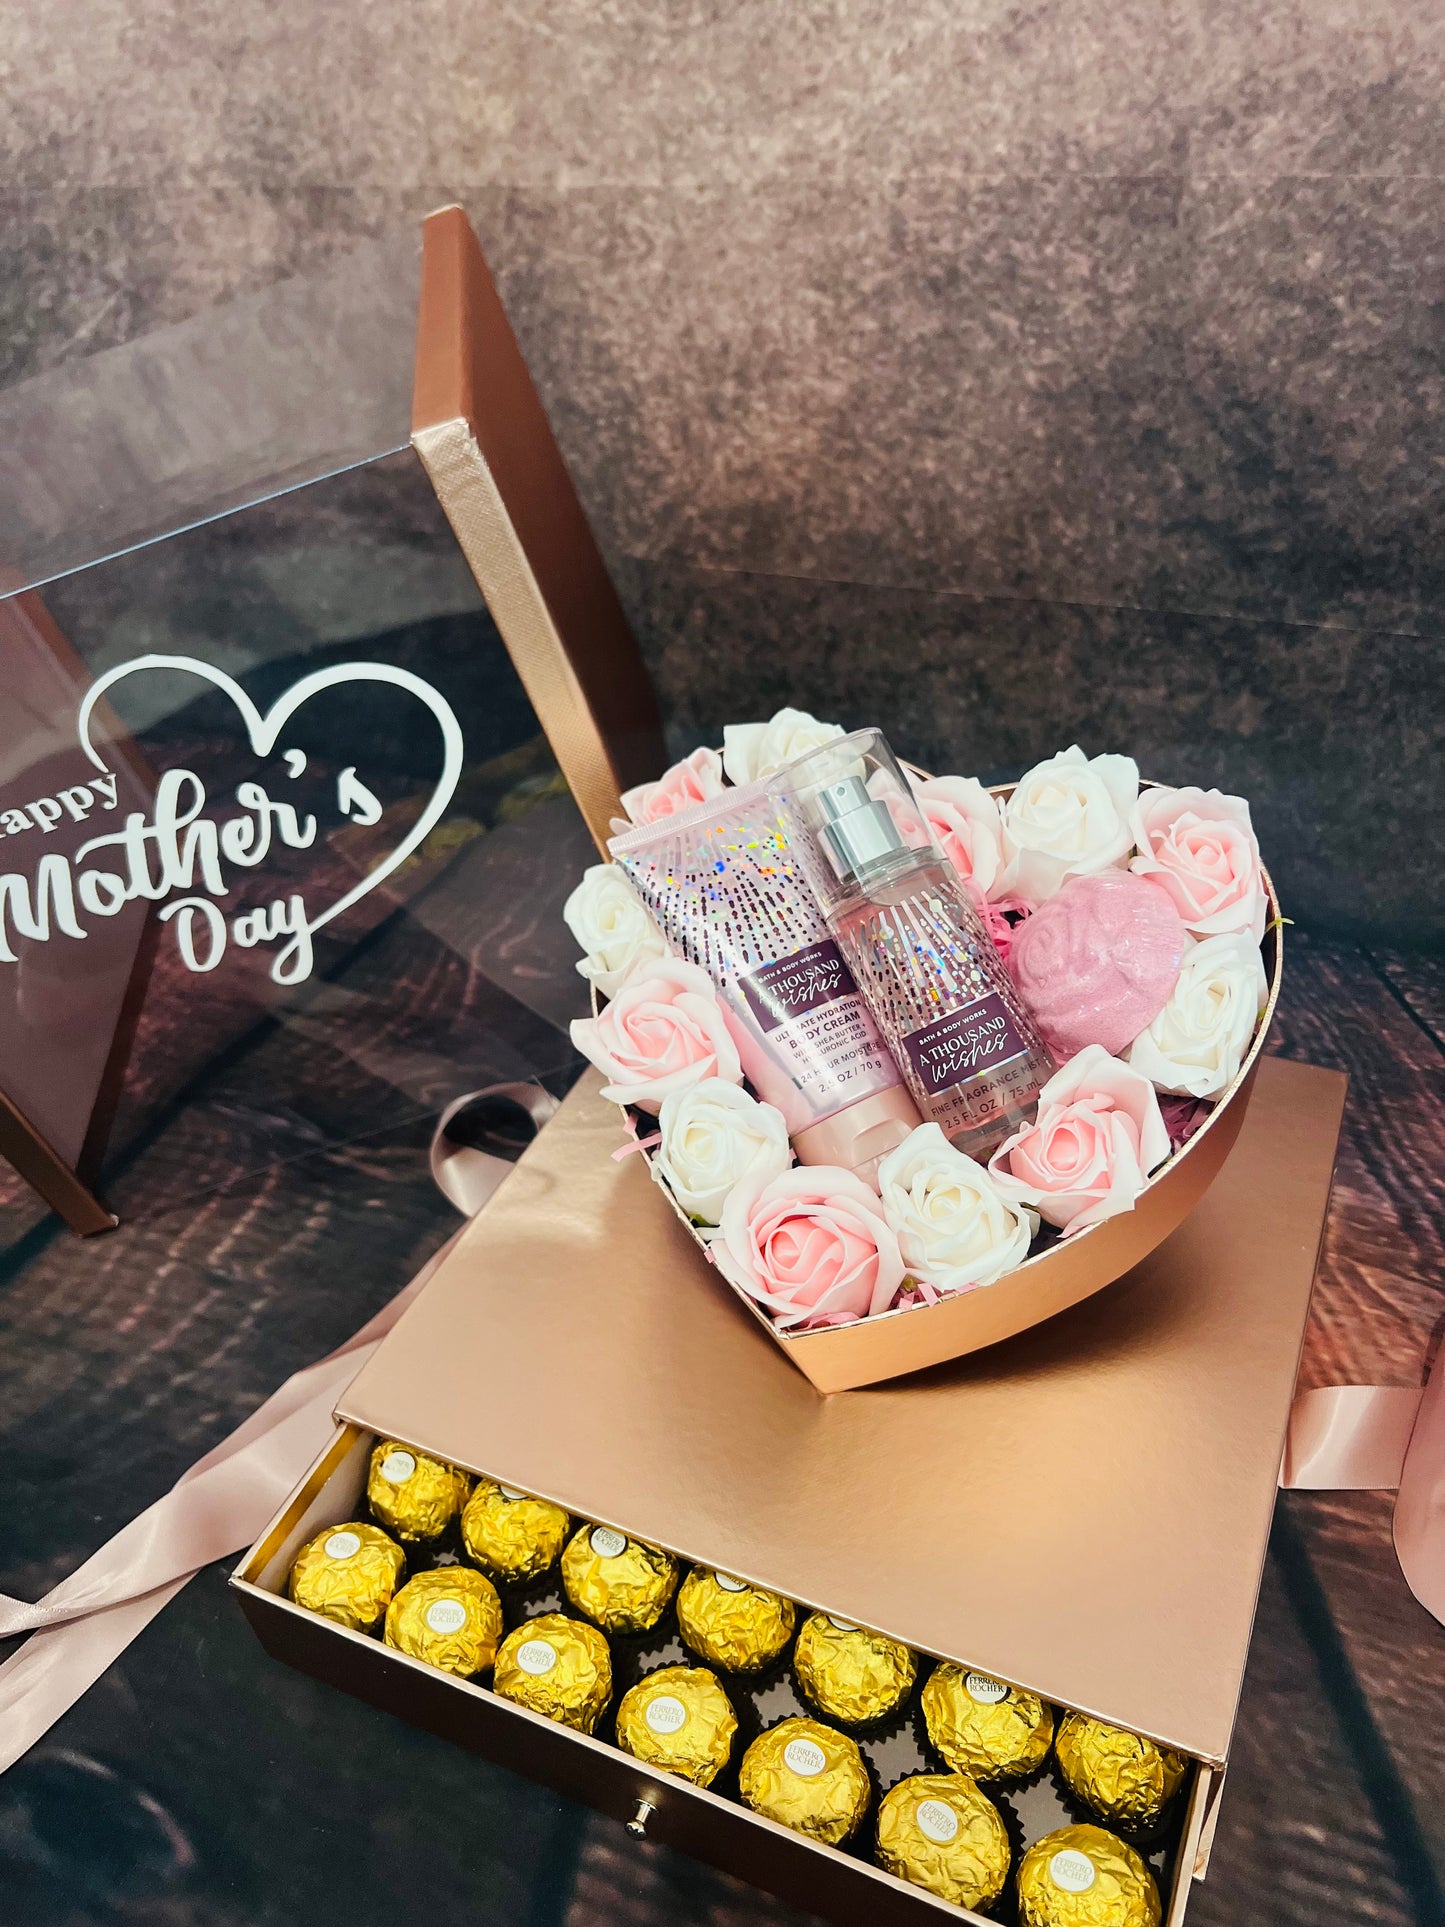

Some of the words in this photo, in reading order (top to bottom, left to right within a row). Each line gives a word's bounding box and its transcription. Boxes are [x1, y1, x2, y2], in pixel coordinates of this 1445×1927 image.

[0, 773, 118, 839] appy
[0, 748, 383, 962] Mother's
[158, 895, 314, 985] Day
[767, 959, 839, 996] THOUSAND
[781, 960, 800, 973] BODY
[799, 951, 823, 964] WORKS
[774, 1017, 817, 1043] ULTATE
[816, 999, 861, 1021] HYDRATION
[788, 1027, 821, 1049] BDY
[823, 1010, 861, 1032] CREAM
[814, 1035, 834, 1049] SHEA
[834, 1023, 862, 1039] BUTTER
[850, 1030, 867, 1041] ACID
[918, 1033, 936, 1046] BATH
[942, 1020, 961, 1034] BODY
[961, 1008, 988, 1024] WORKS
[813, 1058, 840, 1077] HUR
[840, 1041, 881, 1063] MOISTURE
[919, 1054, 930, 1067] A
[928, 1016, 1006, 1060] THOUSAND
[837, 1070, 853, 1083] OZ
[860, 1061, 873, 1072] 70
[874, 1060, 882, 1069] g
[931, 1102, 952, 1117] FINE
[951, 1069, 1020, 1108] FRAGRANCE
[1020, 1059, 1042, 1075] MIST
[945, 1115, 961, 1129] 2.5
[961, 1110, 978, 1122] FL
[979, 1098, 998, 1113] OZ
[1009, 1086, 1025, 1099] 75
[1026, 1077, 1043, 1091] mL
[969, 1684, 1005, 1693] ROCHER
[787, 1752, 821, 1769] ROCHER
[789, 1744, 824, 1762] FERRERO
